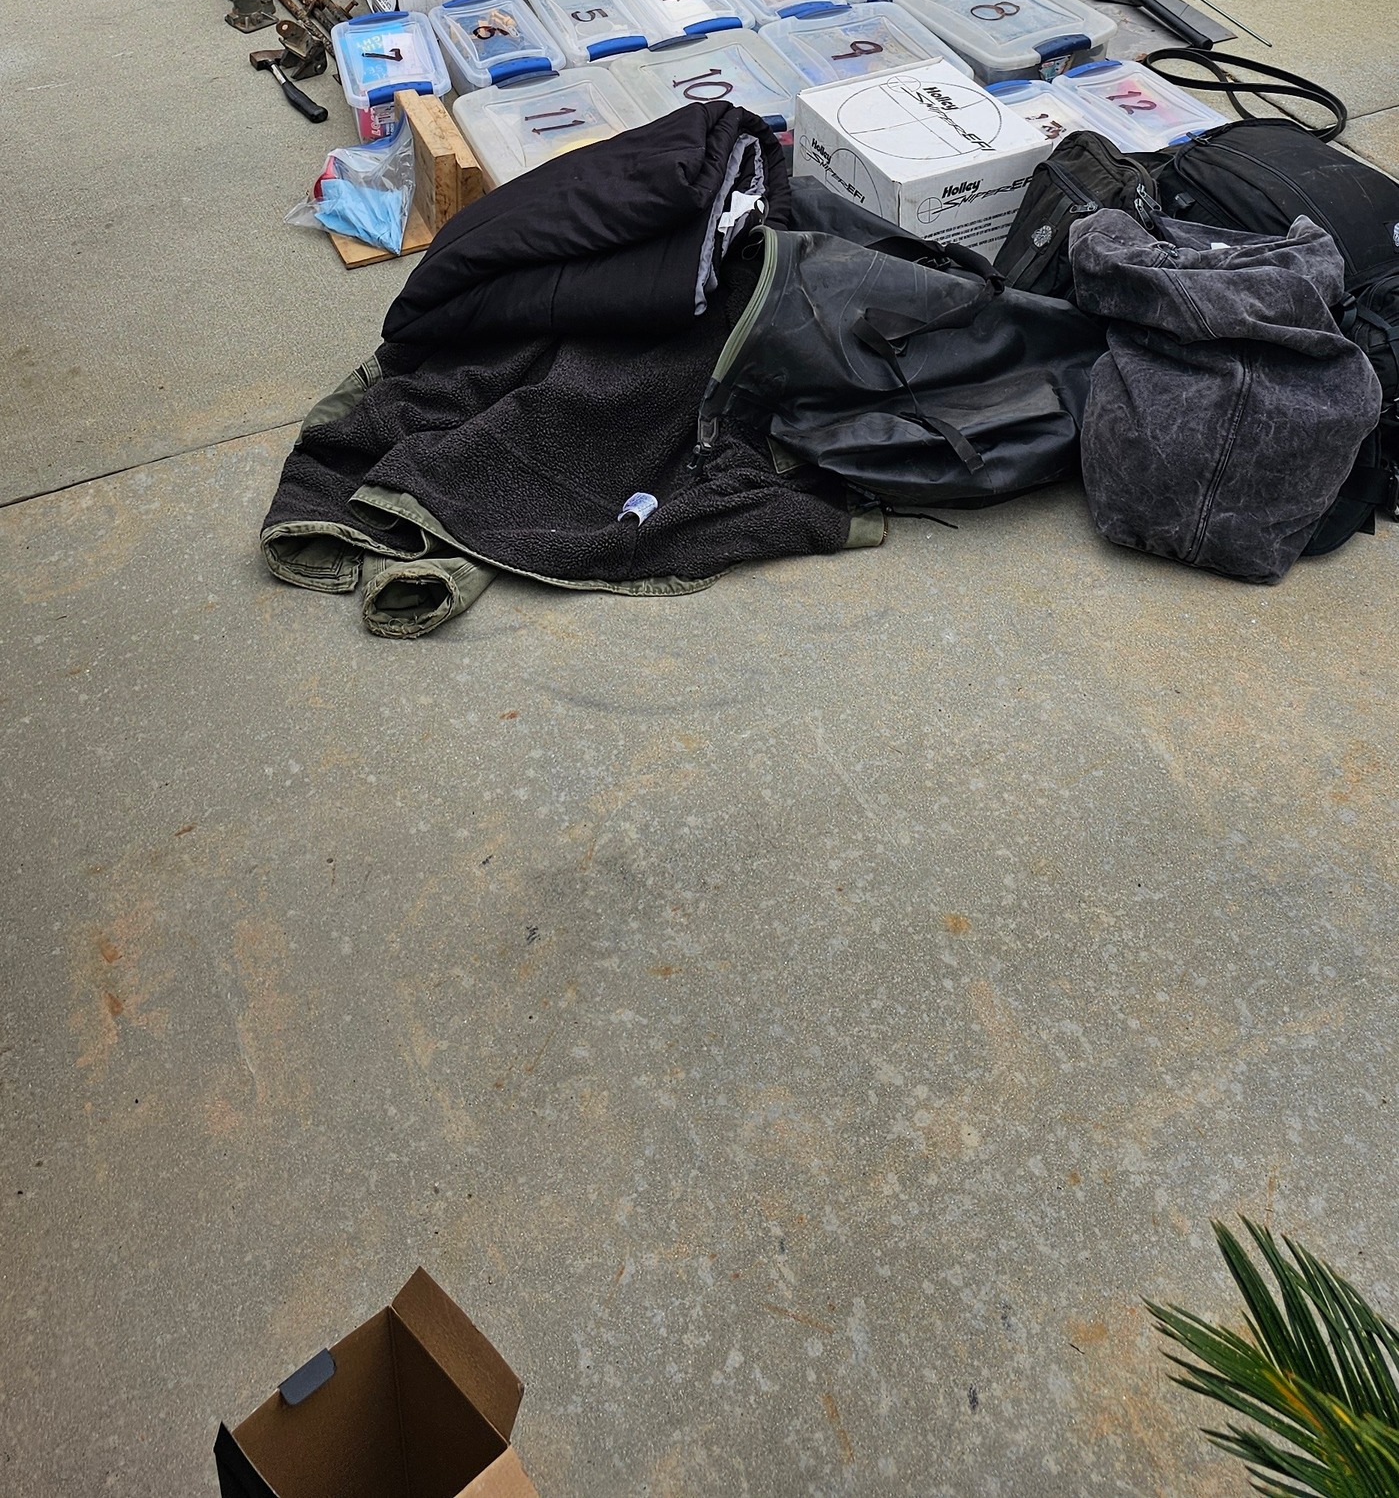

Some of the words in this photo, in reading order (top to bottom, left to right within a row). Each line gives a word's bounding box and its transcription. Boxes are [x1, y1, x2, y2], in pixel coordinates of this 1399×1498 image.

[571, 8, 608, 22] 5
[970, 1, 1020, 21] 8
[361, 48, 404, 62] 7
[831, 40, 884, 61] 9
[672, 68, 734, 101] 10
[922, 86, 960, 111] Holley
[1105, 90, 1157, 115] 12
[524, 107, 586, 136] 11
[811, 137, 832, 165] Holley
[942, 180, 981, 199] Holley
